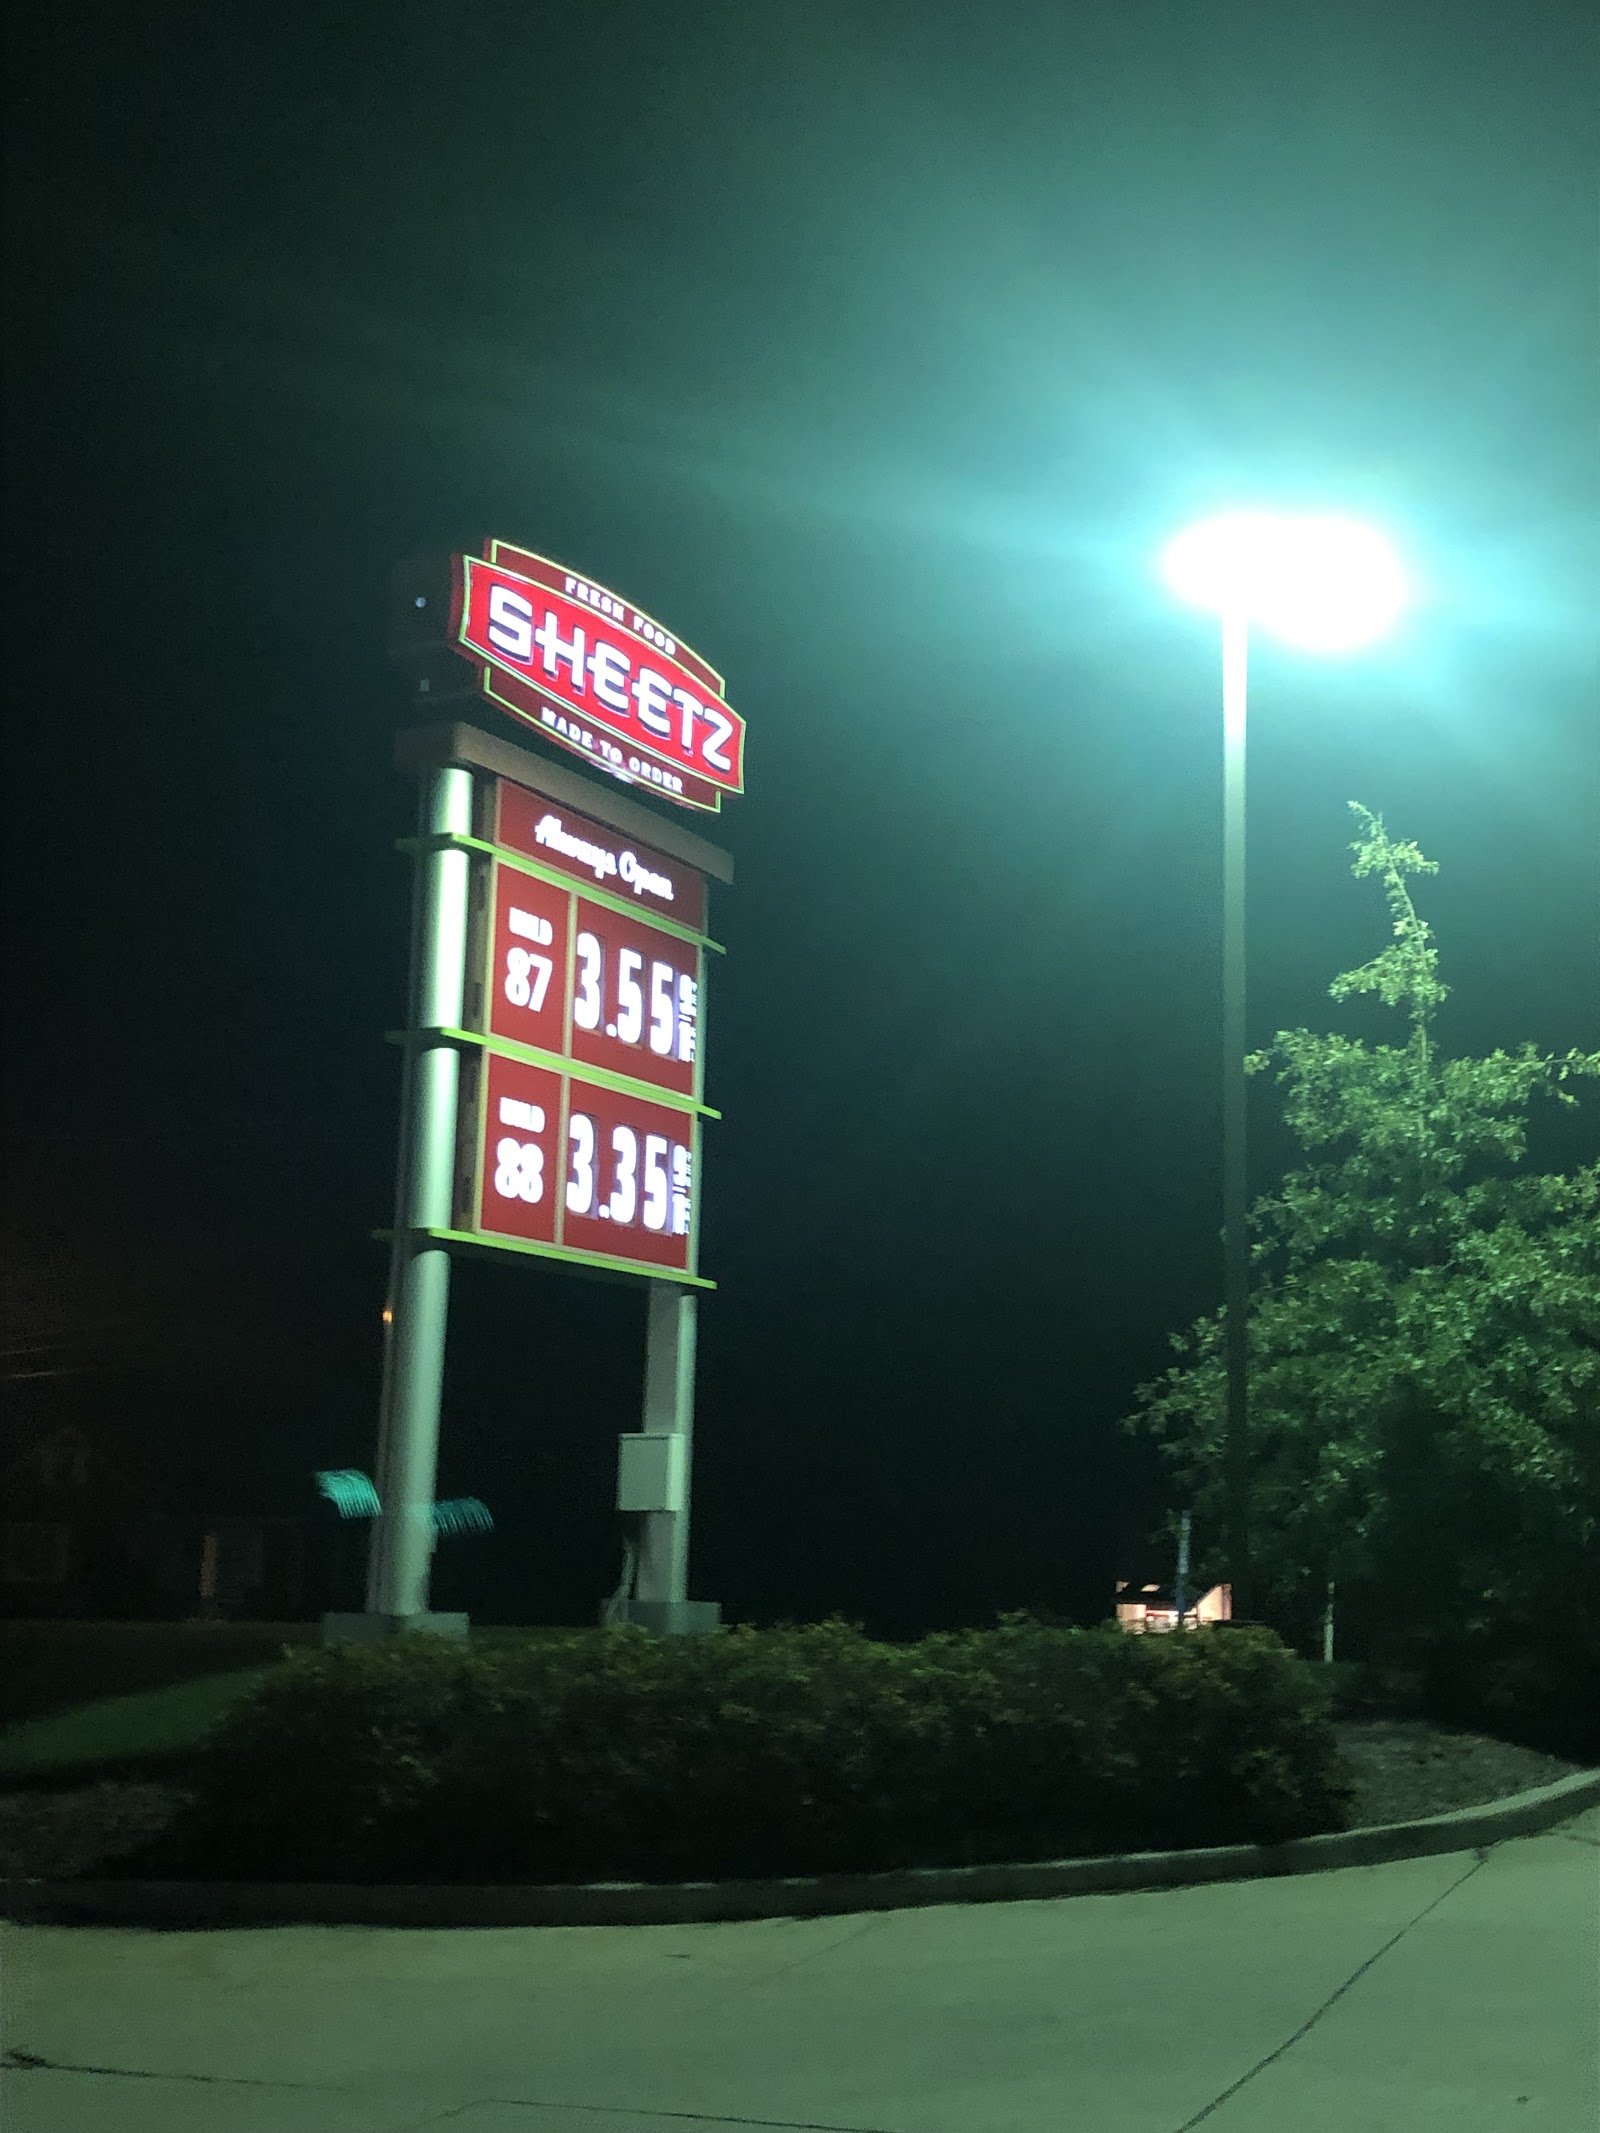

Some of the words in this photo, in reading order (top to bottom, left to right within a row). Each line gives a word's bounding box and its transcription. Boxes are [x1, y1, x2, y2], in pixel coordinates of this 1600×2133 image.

[565, 576, 625, 621] FRESH
[633, 615, 675, 655] FOOD
[488, 585, 733, 769] SHEETZ
[541, 707, 593, 749] MADE
[600, 741, 622, 763] TO
[629, 757, 683, 794] ORDER
[534, 814, 617, 879] Always
[505, 947, 552, 1012] 87
[495, 1138, 544, 1203] 88
